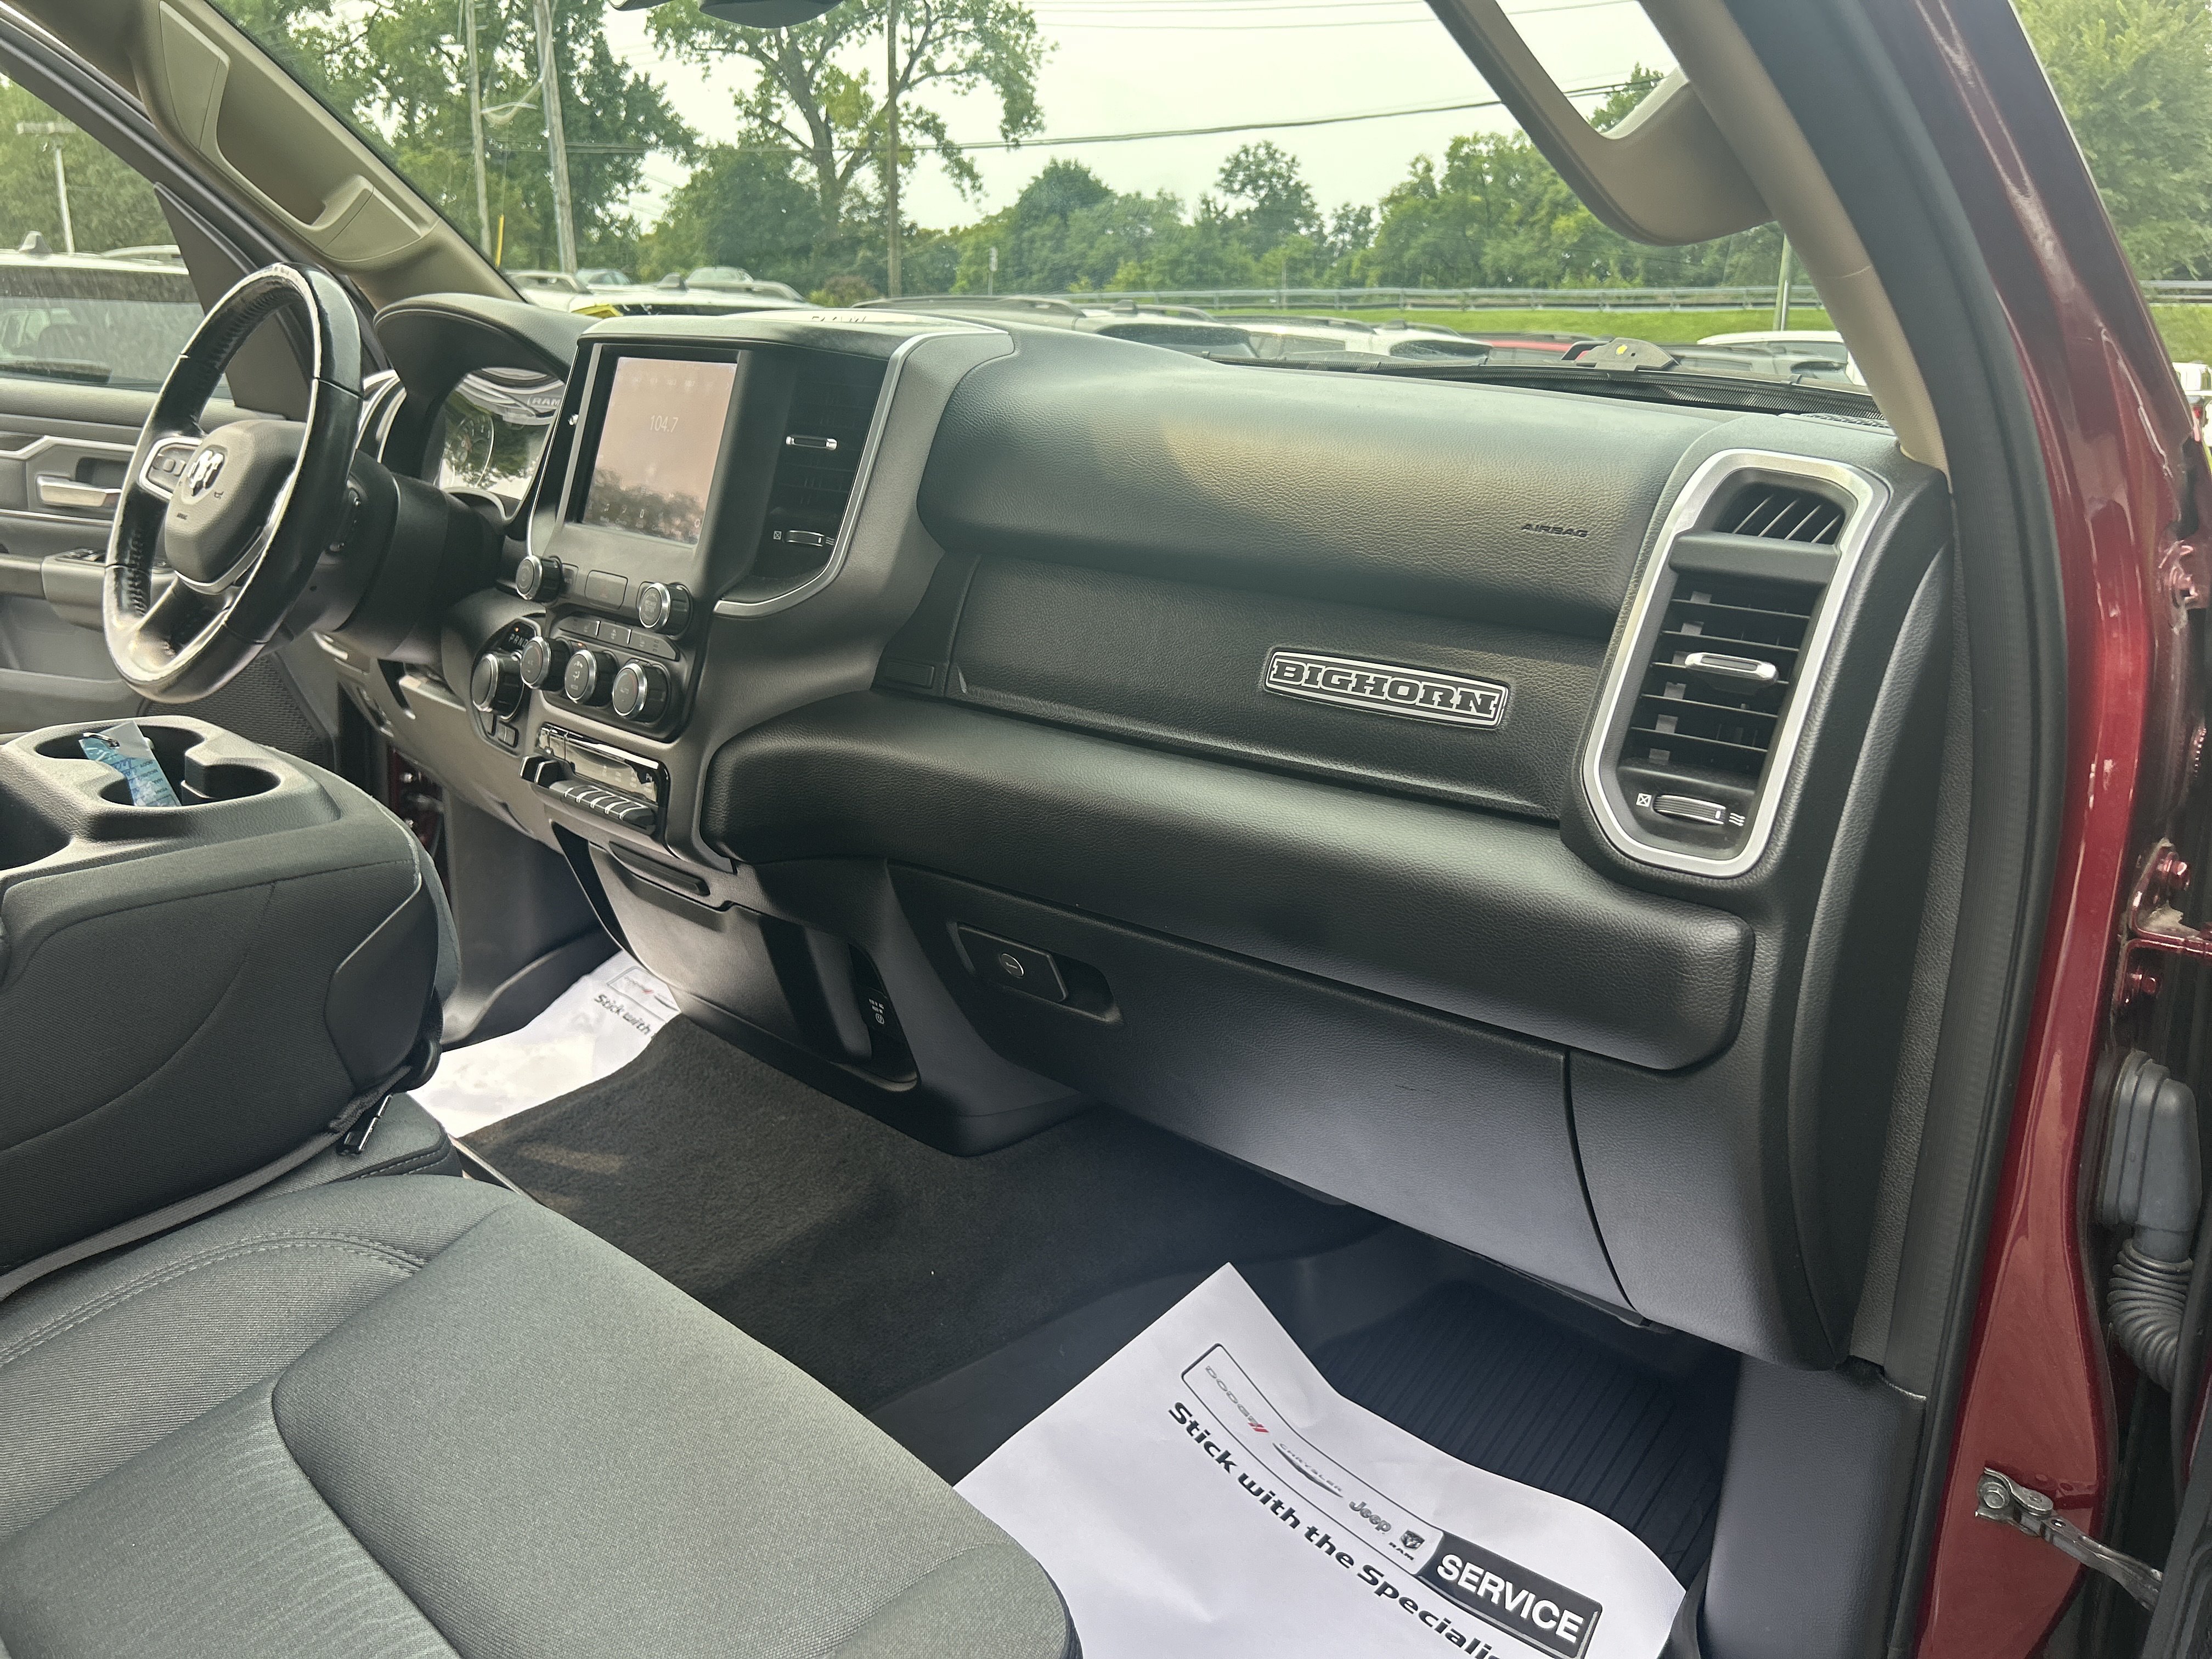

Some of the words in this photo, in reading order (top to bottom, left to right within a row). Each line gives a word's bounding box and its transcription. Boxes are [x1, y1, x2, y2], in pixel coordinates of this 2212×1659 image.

[650, 414, 679, 433] 104.7
[1522, 523, 1588, 538] AIRBAG
[1269, 658, 1502, 719] BIGHORN
[594, 994, 625, 1016] Stick
[622, 1012, 651, 1035] with
[1205, 1365, 1261, 1427] DODGE
[1167, 1402, 1238, 1474] Stick
[1237, 1472, 1301, 1530] with
[1304, 1525, 1355, 1569] the
[1357, 1564, 1500, 1659] Speciali
[1348, 1501, 1391, 1532] Jeep
[1388, 1542, 1415, 1561] RAM
[1436, 1553, 1584, 1644] SERVICE
